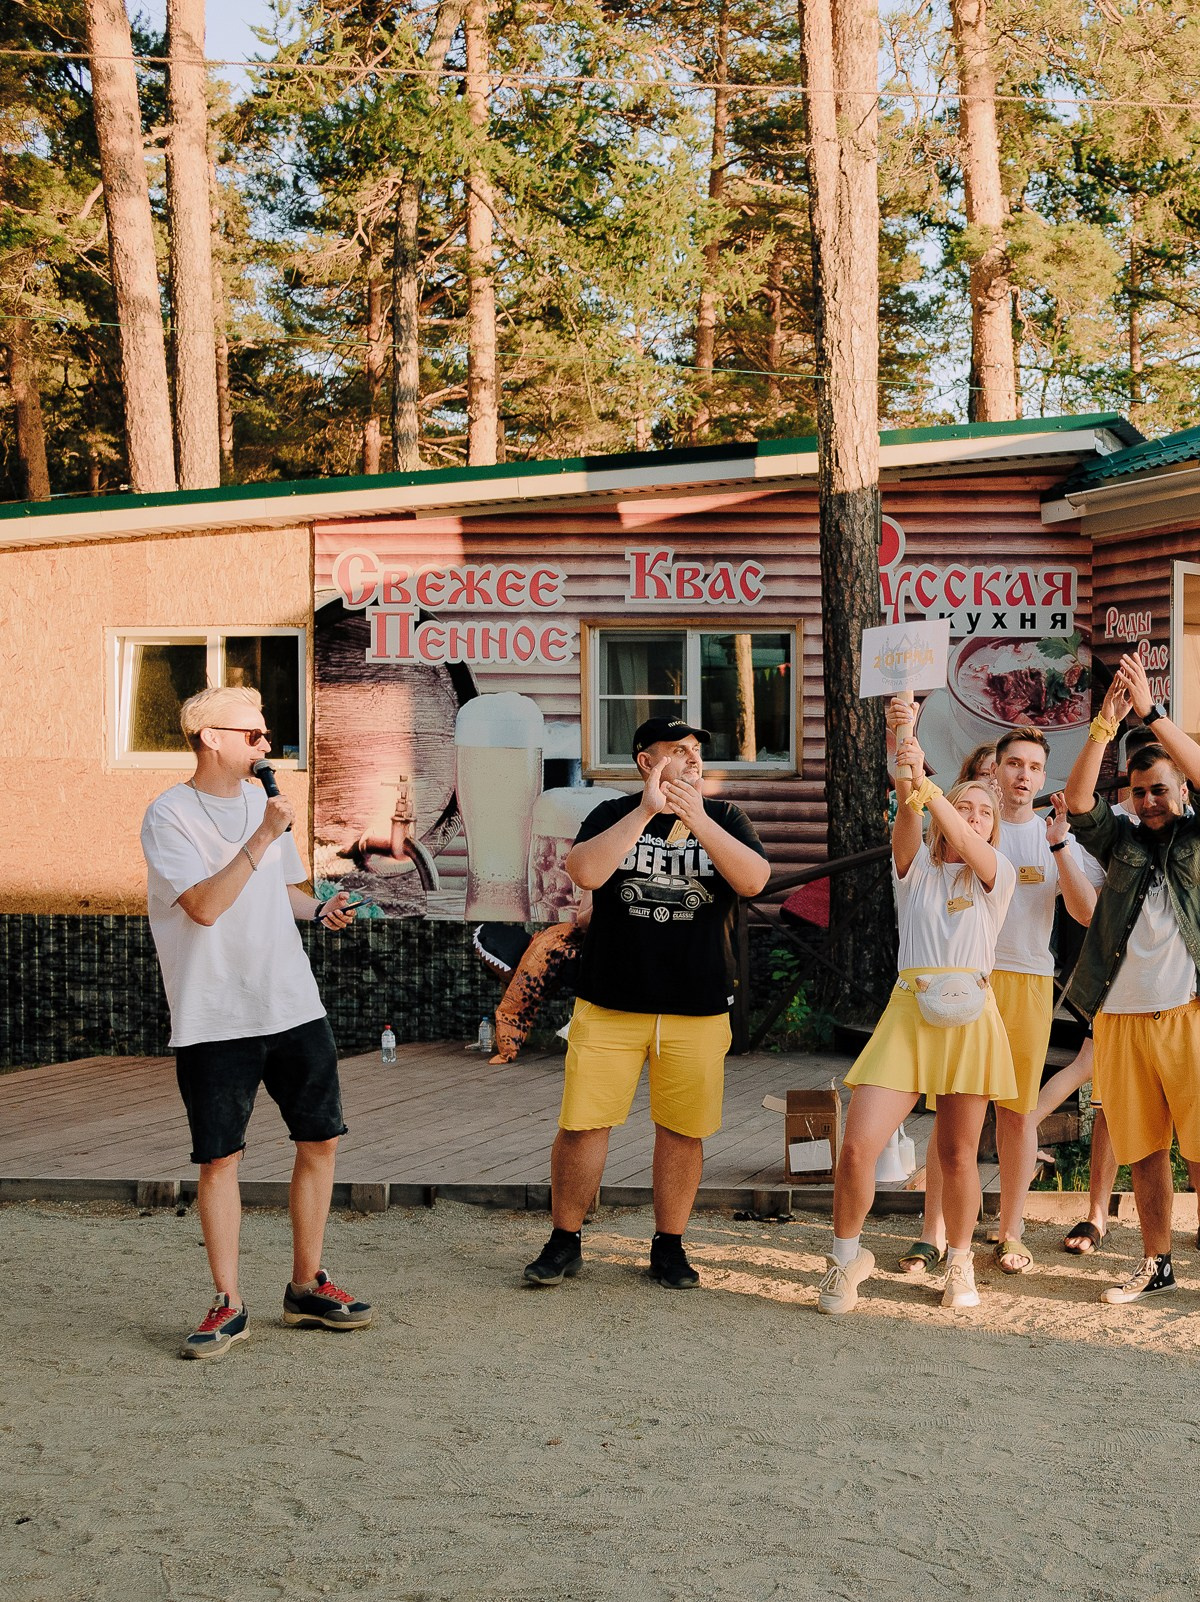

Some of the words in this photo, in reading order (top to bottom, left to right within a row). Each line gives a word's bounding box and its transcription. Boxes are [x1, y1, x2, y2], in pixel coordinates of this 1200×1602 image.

[1106, 608, 1151, 641] Рады
[874, 655, 881, 669] 2
[618, 844, 715, 877] BEETLE
[629, 907, 651, 916] QUALITY
